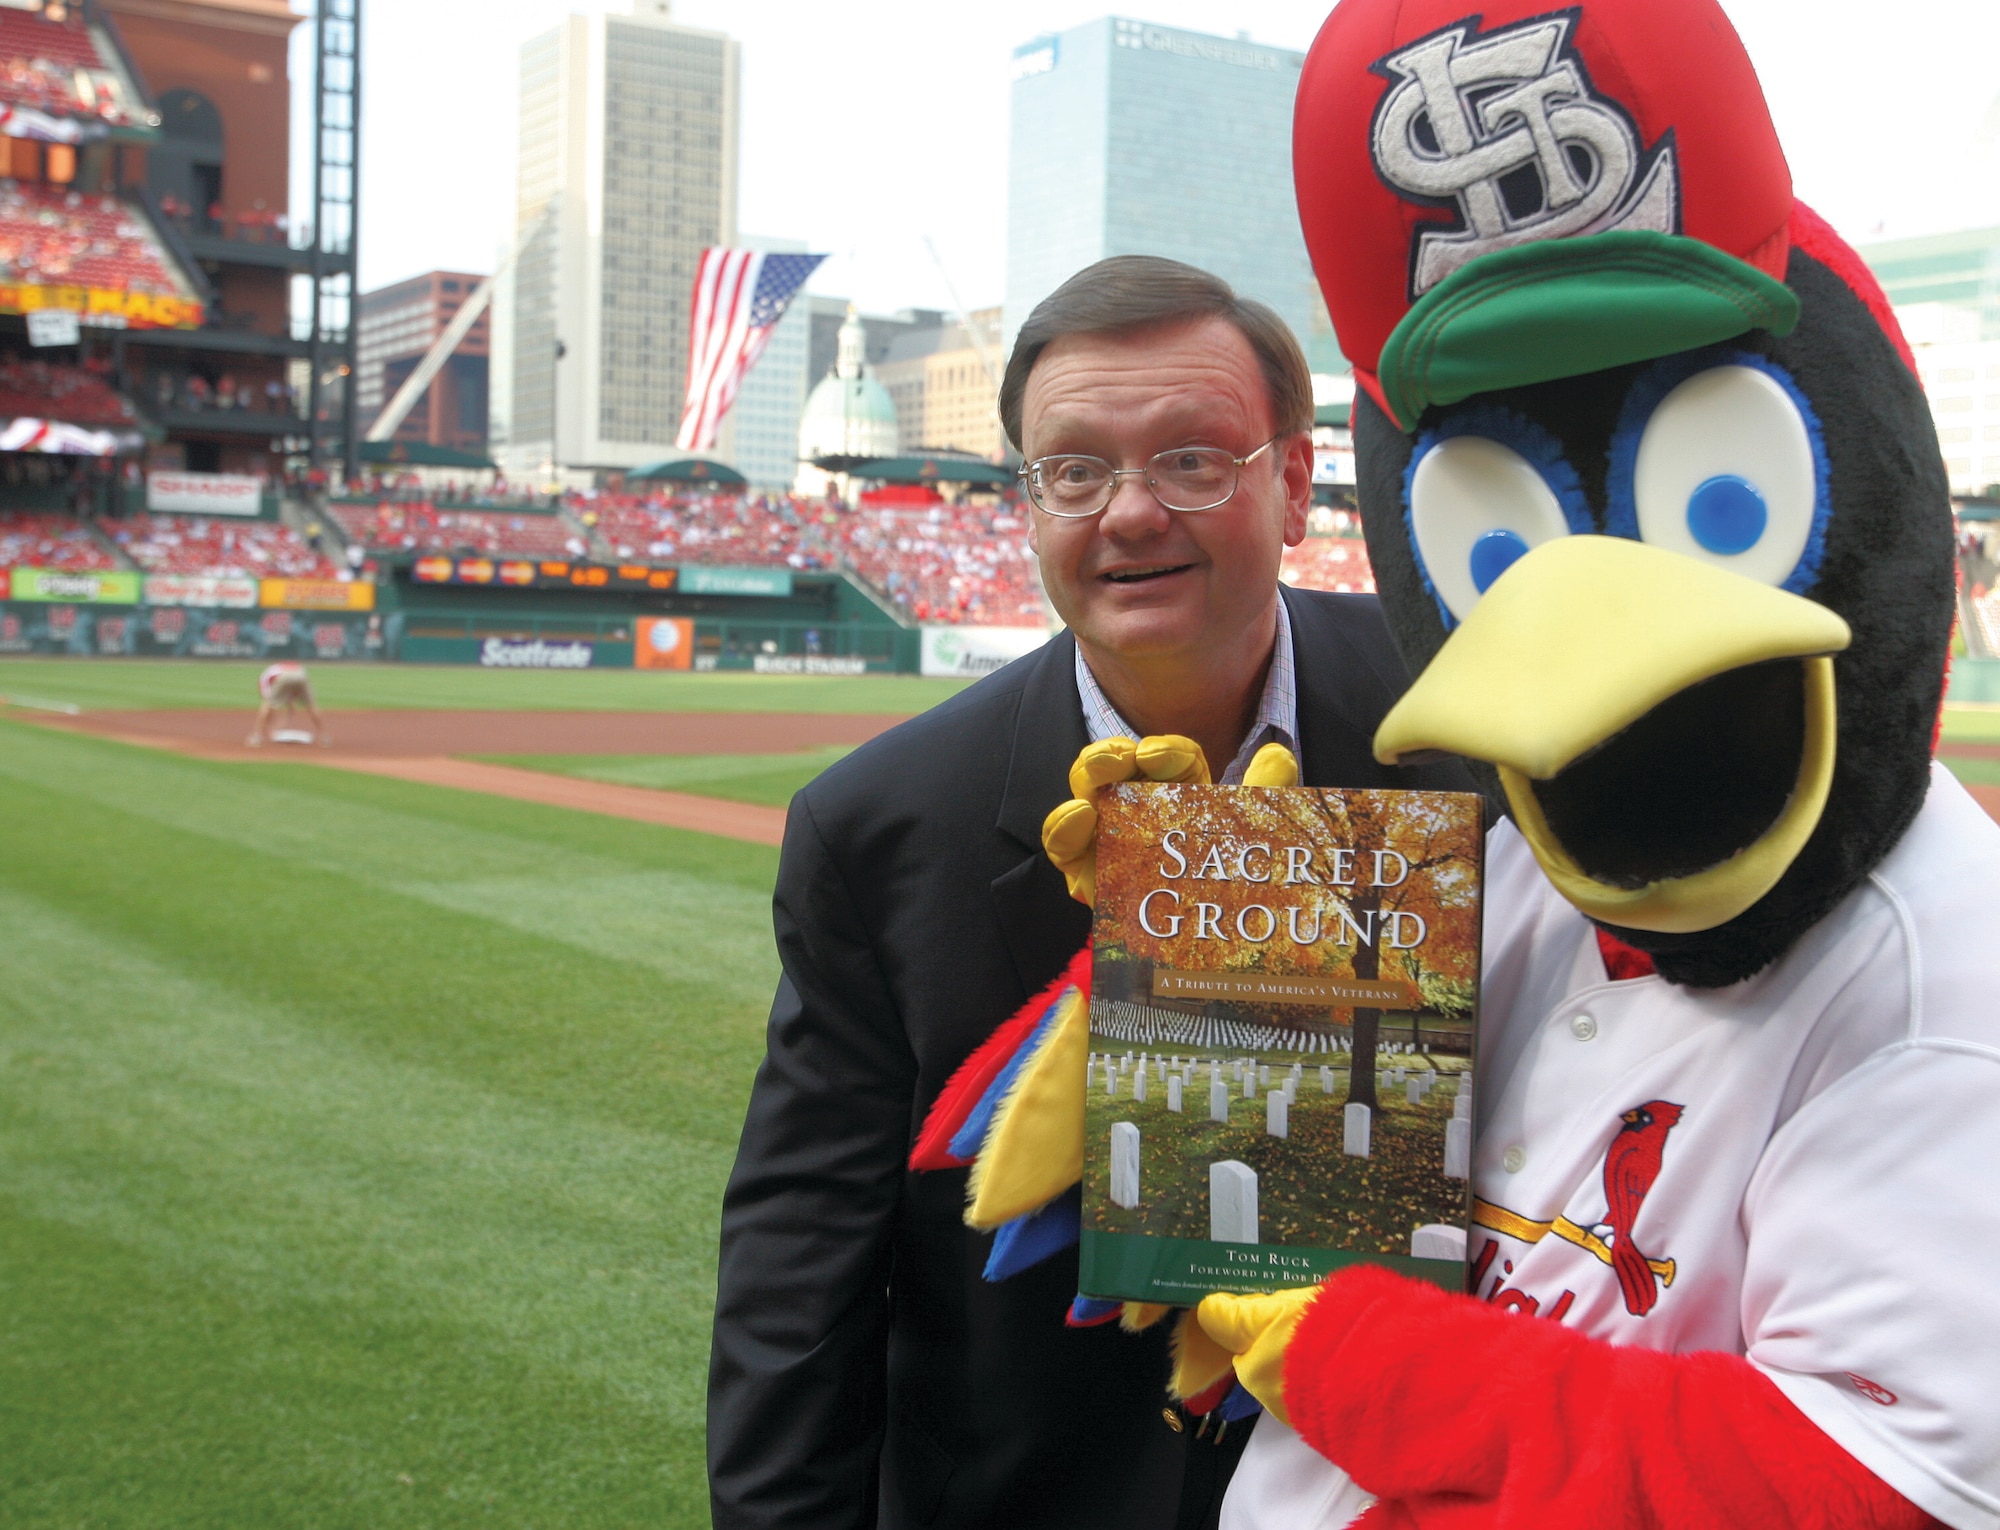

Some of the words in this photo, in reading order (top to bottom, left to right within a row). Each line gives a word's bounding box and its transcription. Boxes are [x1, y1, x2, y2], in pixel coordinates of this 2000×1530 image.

[481, 637, 592, 667] Scottrade
[805, 656, 866, 674] STADIUM
[1159, 830, 1410, 888] SACRED
[1138, 888, 1428, 950] GROUND
[1161, 977, 1170, 988] A
[1176, 978, 1230, 991] TRIBUTE
[1236, 983, 1252, 993] TO
[1257, 983, 1326, 997] AMERICA'S
[1332, 986, 1399, 1000] VETERANS
[1226, 1249, 1260, 1264] TOM
[1269, 1252, 1310, 1268] RUCK
[1190, 1263, 1257, 1279] FOREWORD
[1263, 1270, 1276, 1280] BY
[1283, 1271, 1307, 1283] BOB
